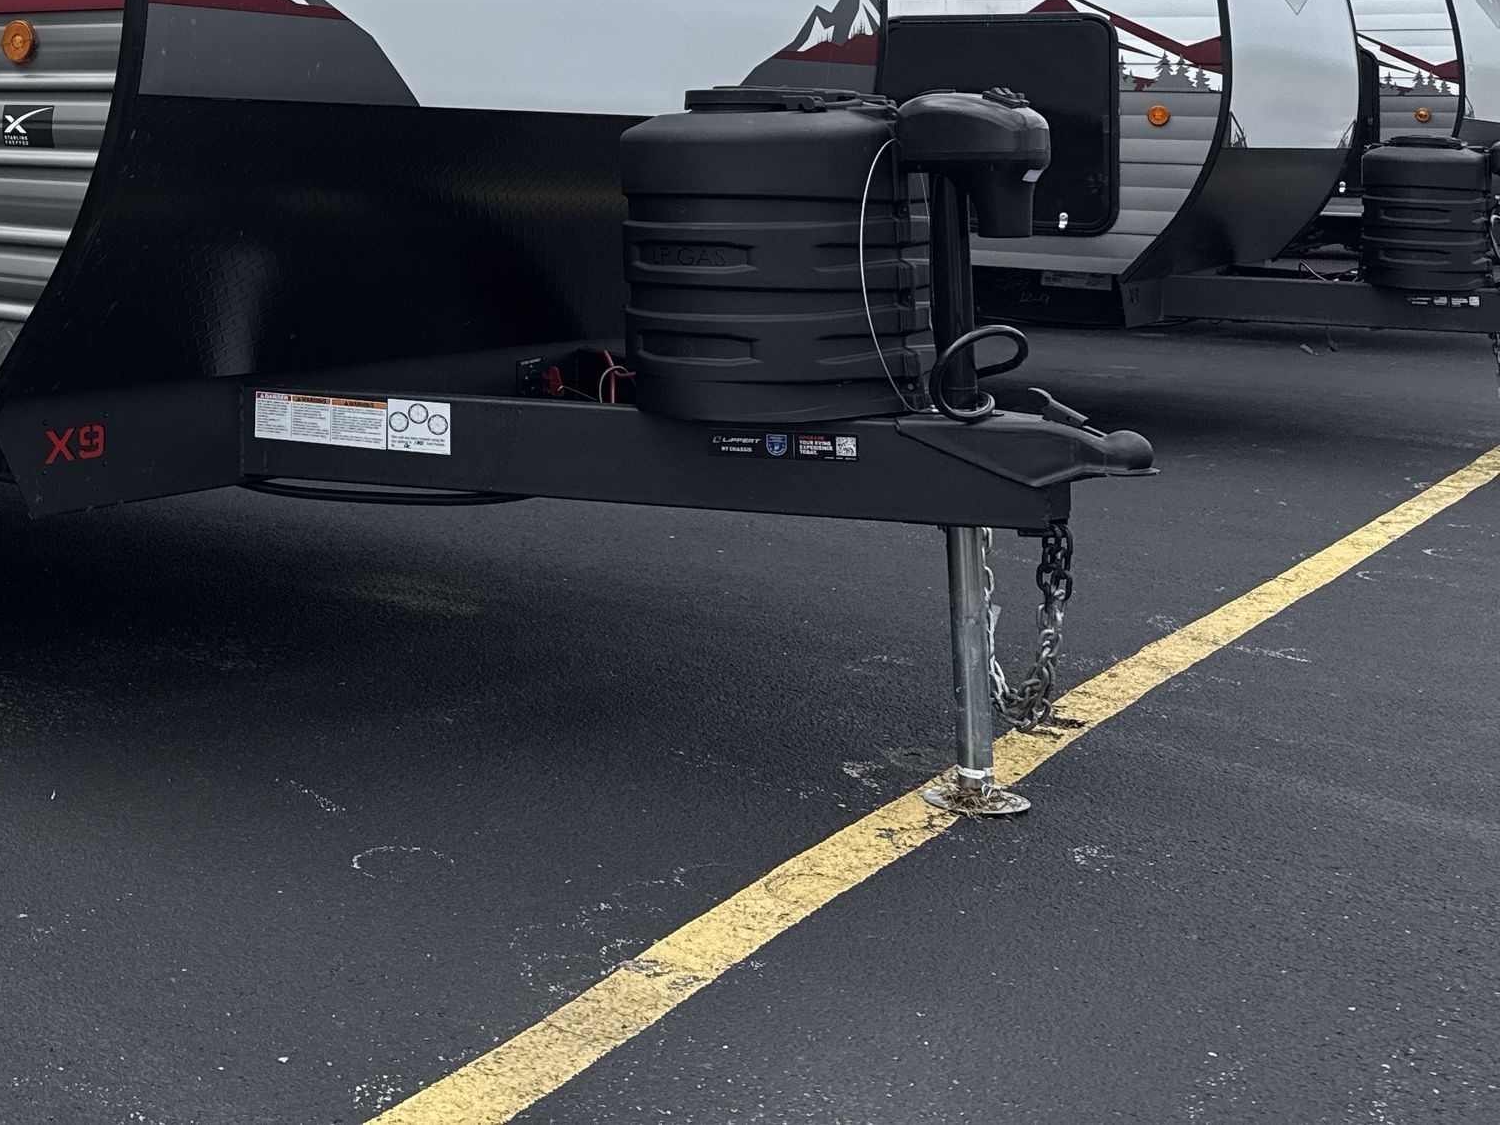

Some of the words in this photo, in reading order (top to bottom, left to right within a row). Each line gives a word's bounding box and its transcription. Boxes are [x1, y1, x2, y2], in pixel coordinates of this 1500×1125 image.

[652, 246, 671, 265] LP
[677, 246, 726, 267] GAS
[45, 424, 105, 465] X9
